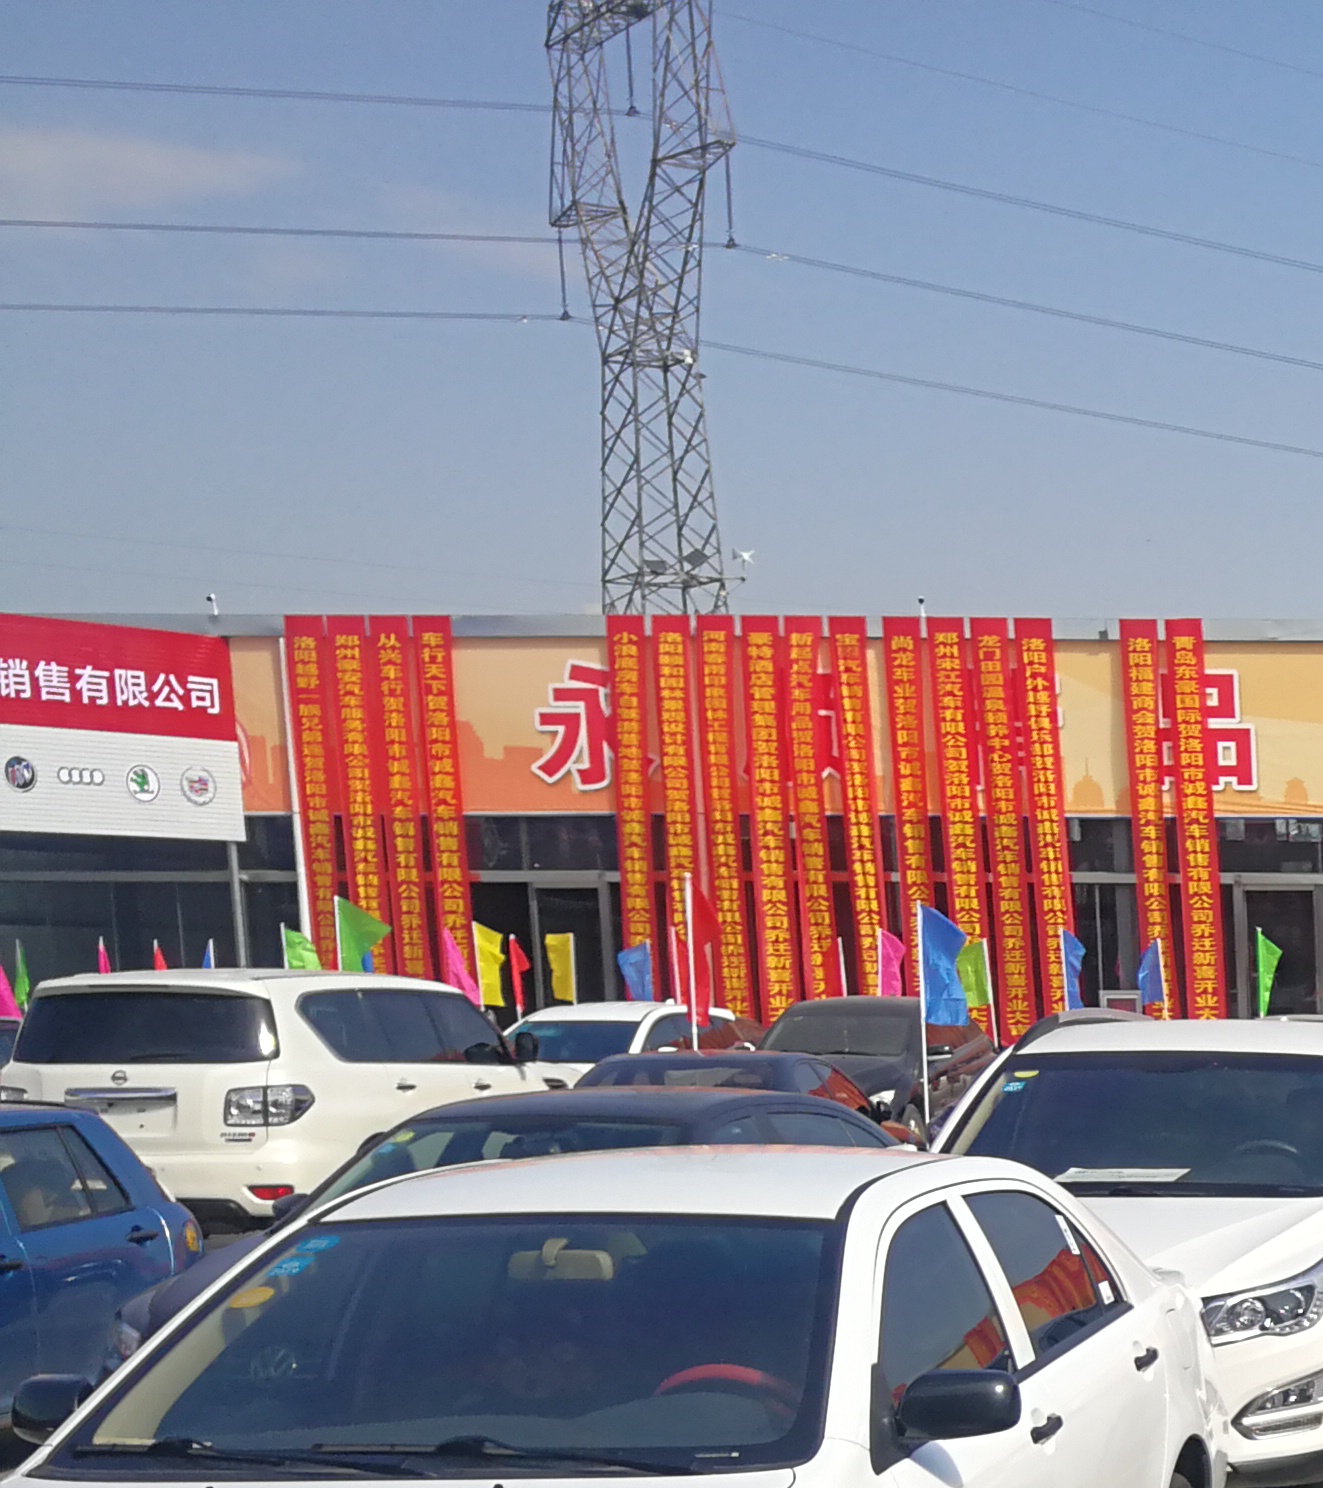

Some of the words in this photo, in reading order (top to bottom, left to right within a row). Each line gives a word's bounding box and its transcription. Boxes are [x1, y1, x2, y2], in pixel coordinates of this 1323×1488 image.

[0, 657, 222, 716] 销售有限公司
